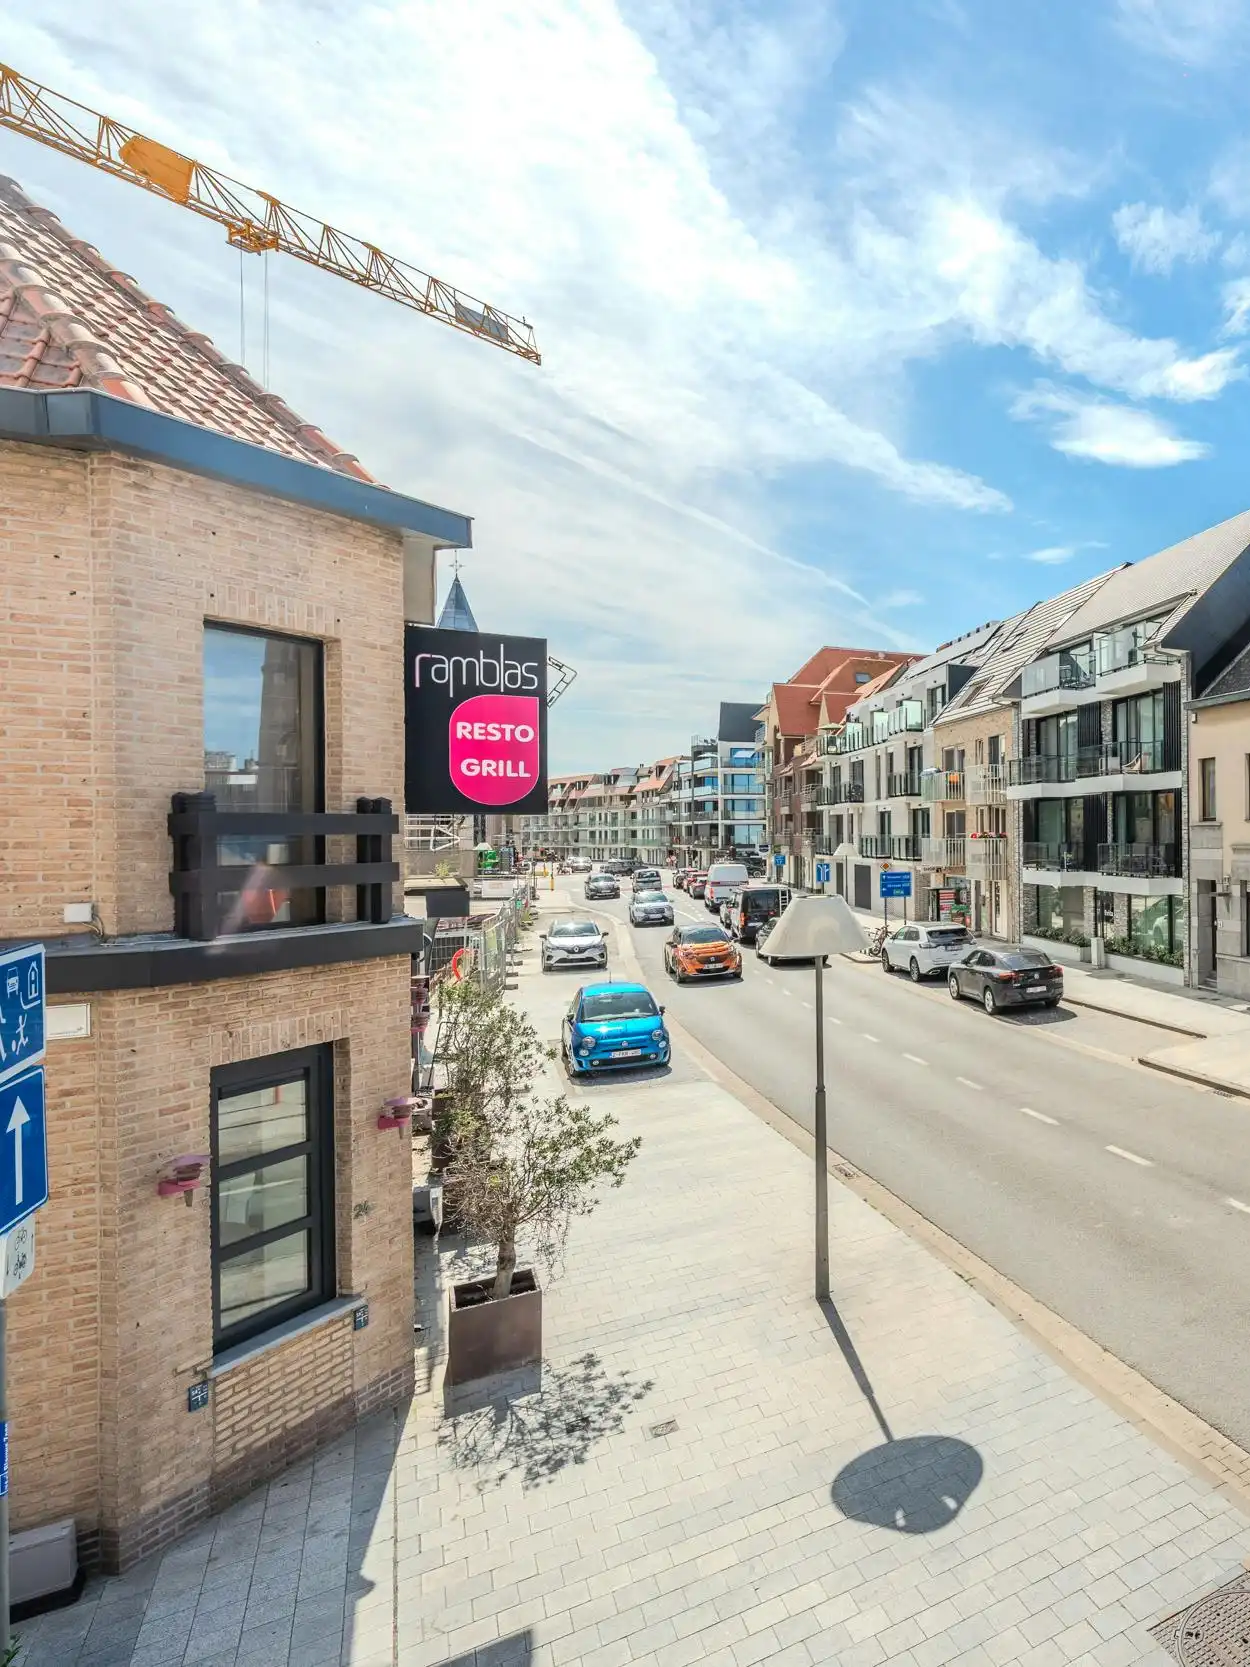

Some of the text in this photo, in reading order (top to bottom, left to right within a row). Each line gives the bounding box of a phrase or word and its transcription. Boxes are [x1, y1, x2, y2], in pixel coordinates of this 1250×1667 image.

[414, 643, 539, 698] ramblas
[456, 722, 535, 743] RESTO
[460, 758, 531, 778] GRILL
